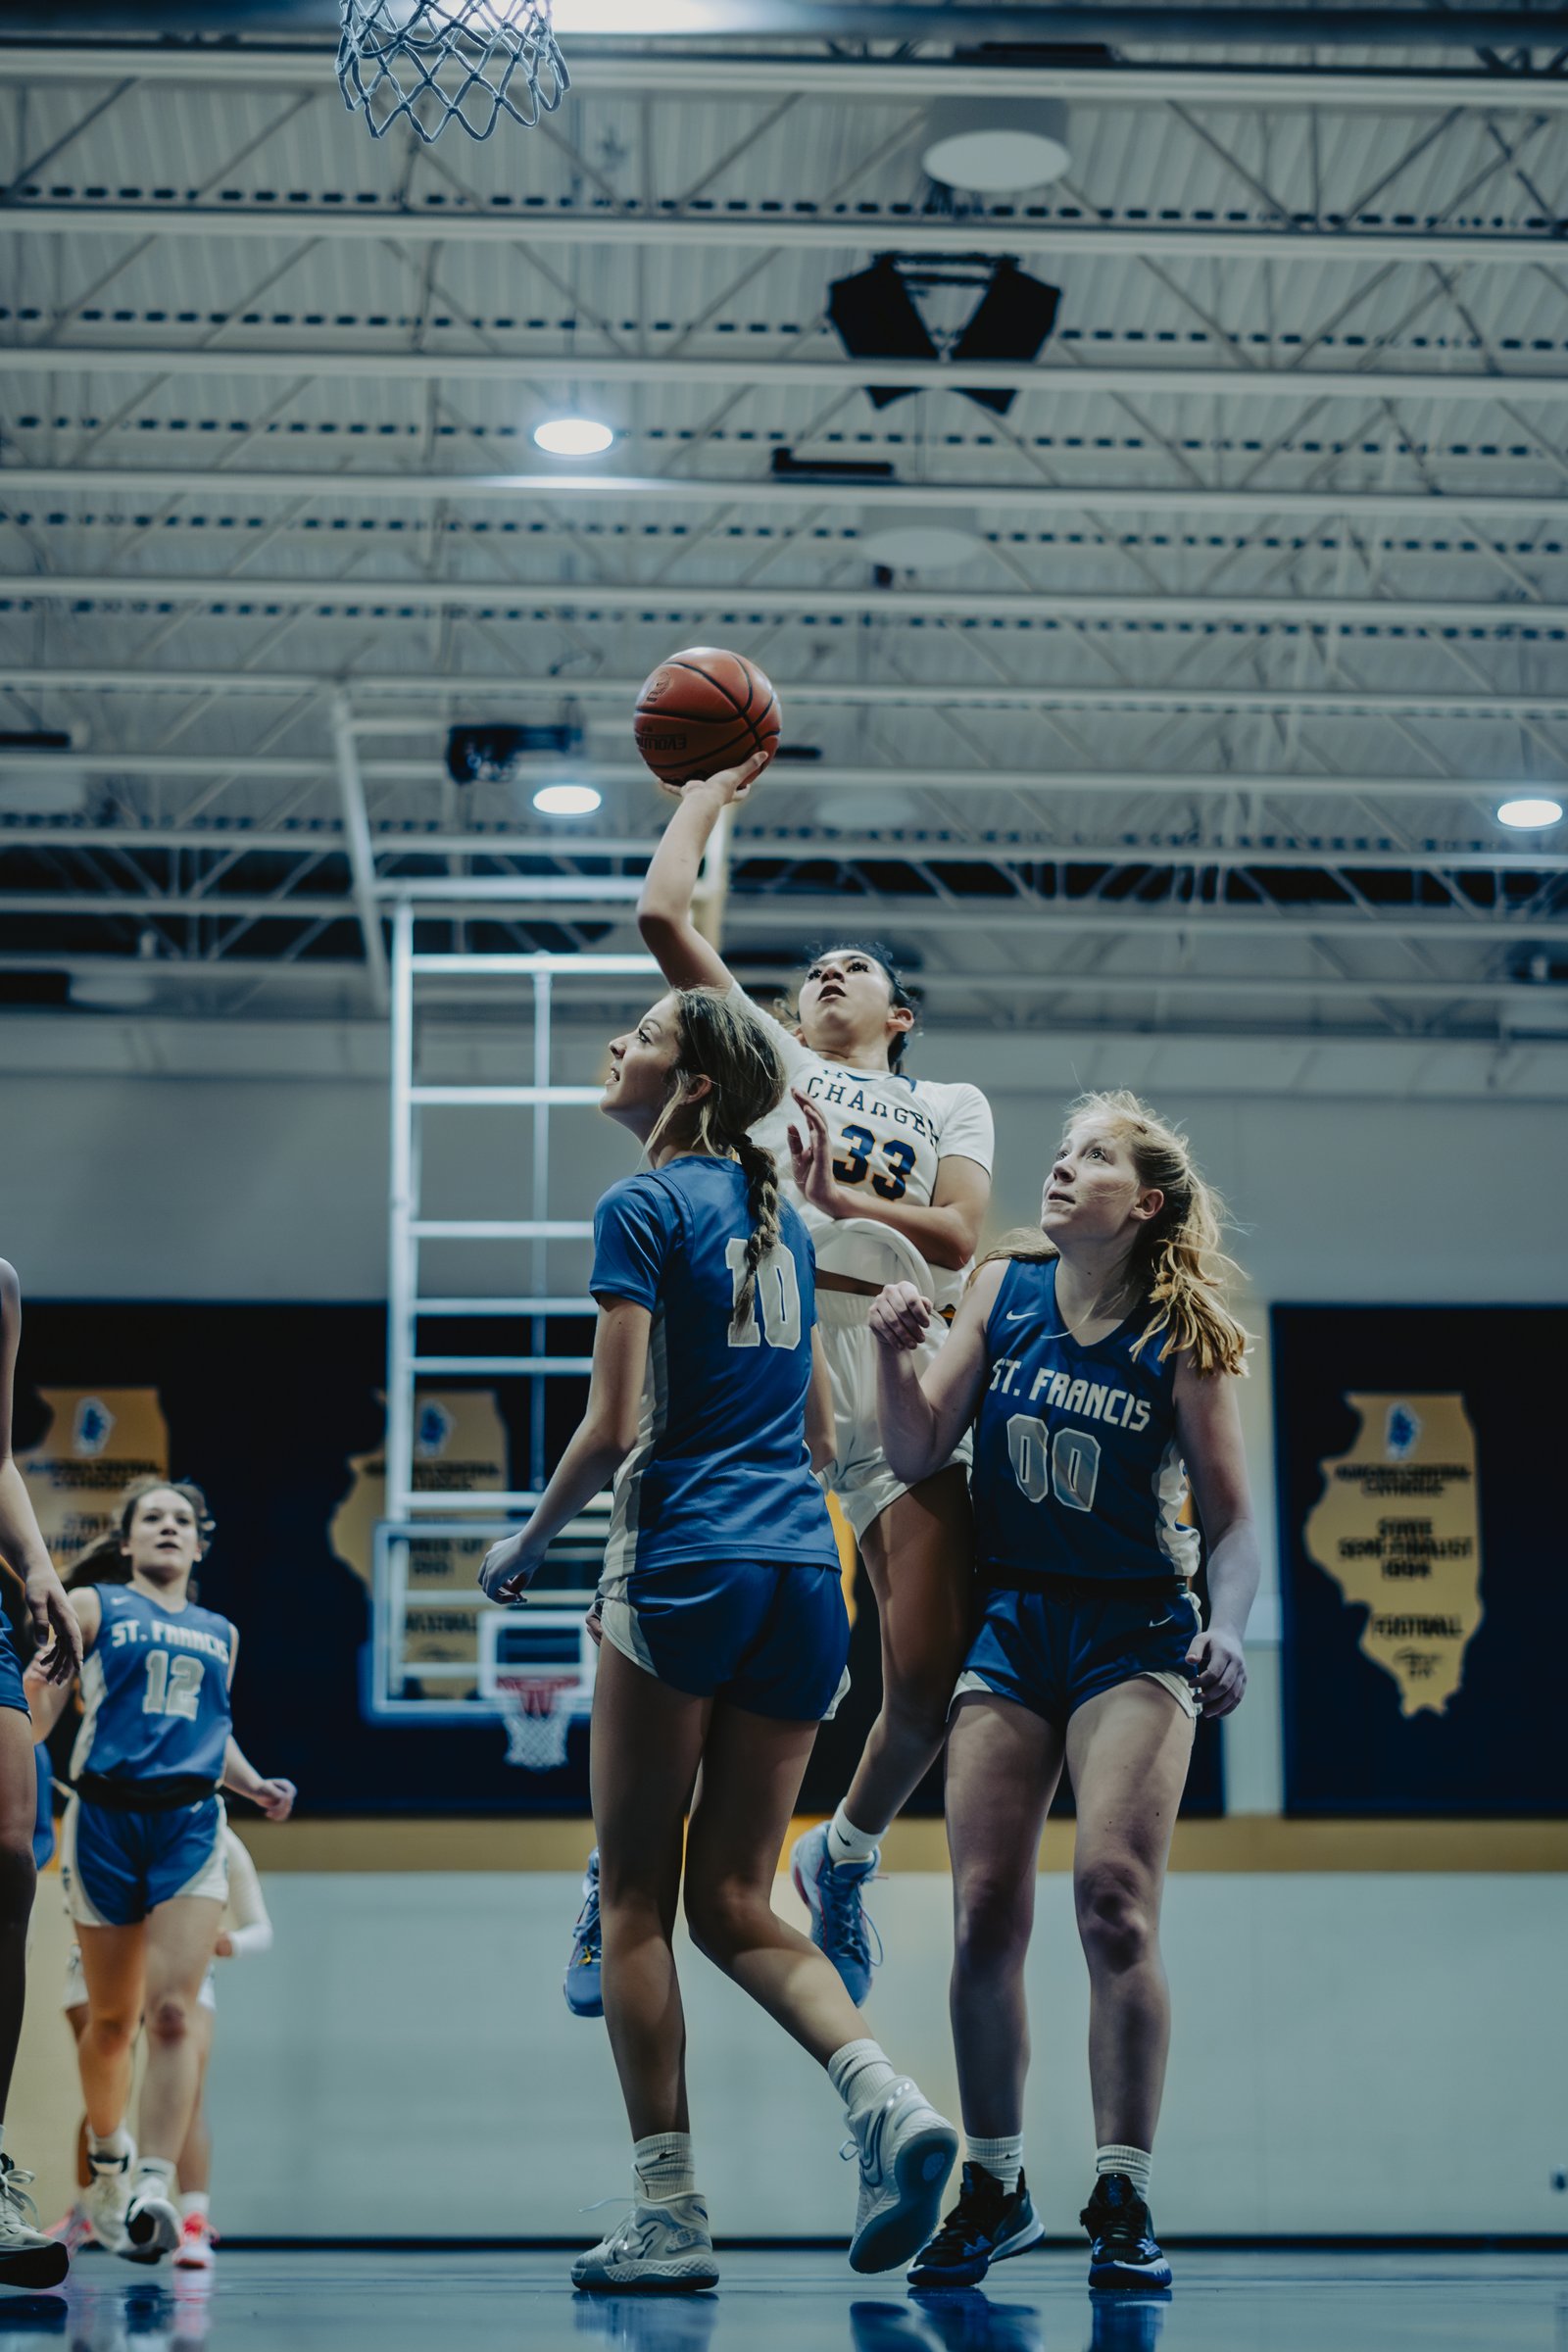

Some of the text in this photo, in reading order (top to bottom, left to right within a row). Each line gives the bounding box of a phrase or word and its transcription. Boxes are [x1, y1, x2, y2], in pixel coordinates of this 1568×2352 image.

[832, 1124, 916, 1201] 33
[725, 1238, 801, 1350] 10
[990, 1358, 1152, 1433] ST. FRANCIS
[1006, 1413, 1102, 1512] 00
[111, 1619, 147, 1647] ST.
[142, 1649, 205, 1722] 12
